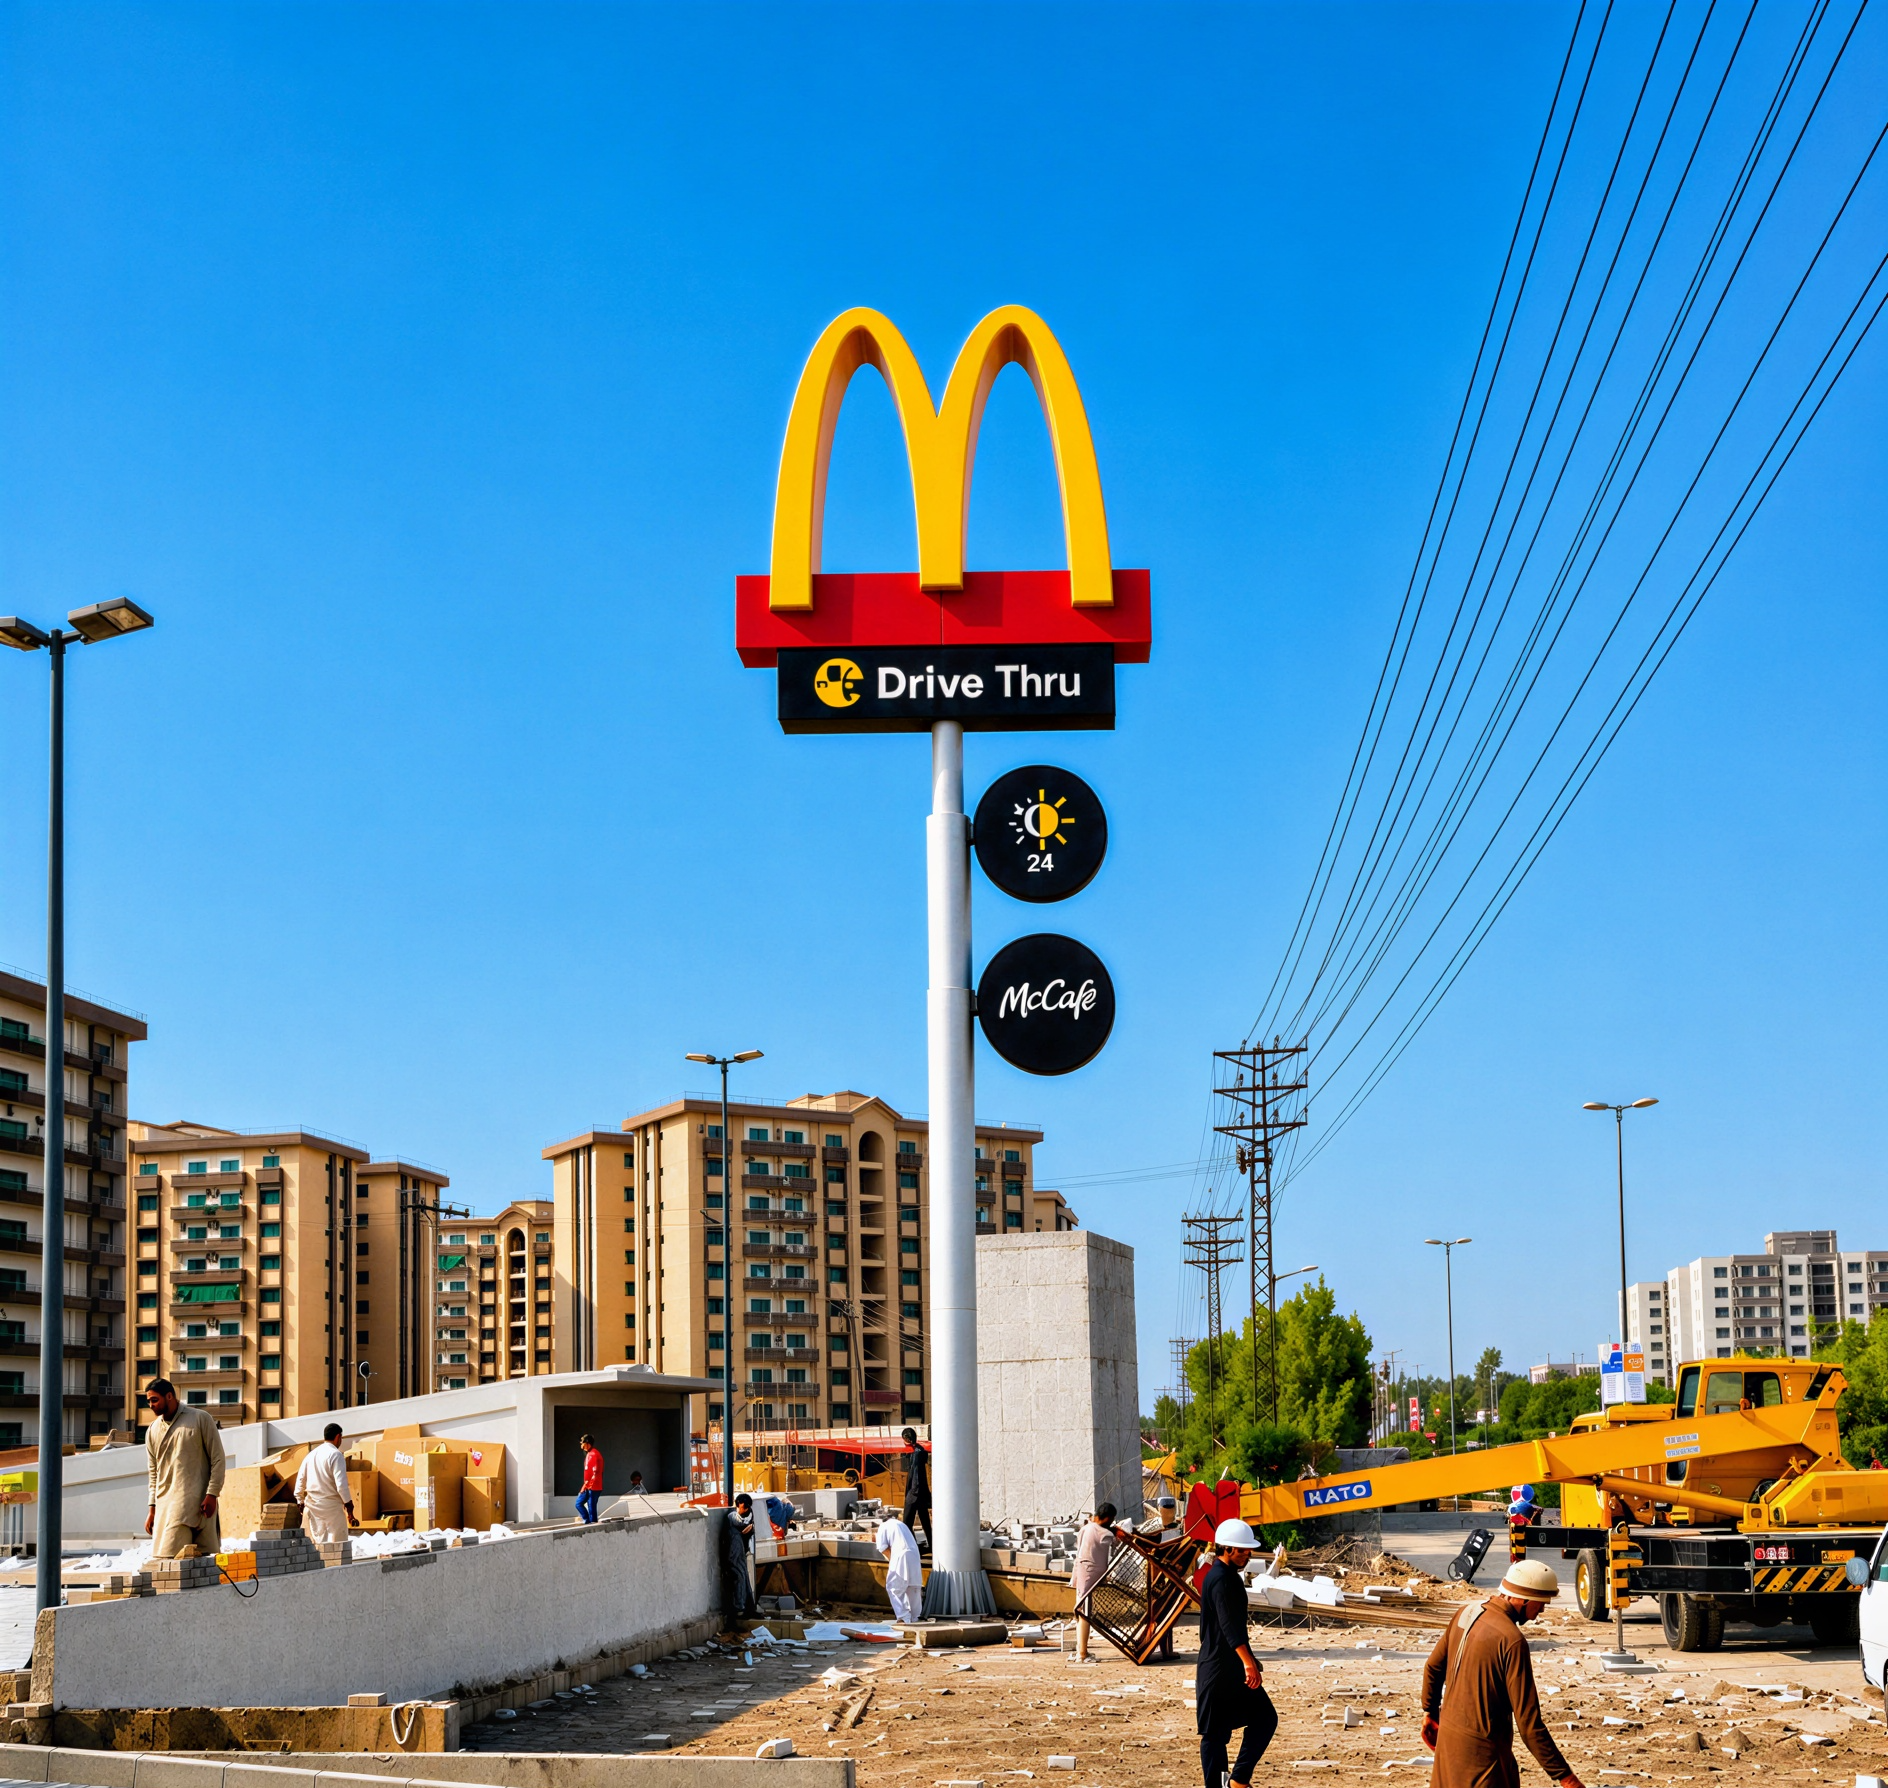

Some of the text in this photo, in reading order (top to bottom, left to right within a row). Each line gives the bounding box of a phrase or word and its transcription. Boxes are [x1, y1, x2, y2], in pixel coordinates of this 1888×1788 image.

[878, 663, 1081, 699] Drive Thru
[1026, 853, 1055, 873] 24
[1308, 1484, 1367, 1505] KATO
